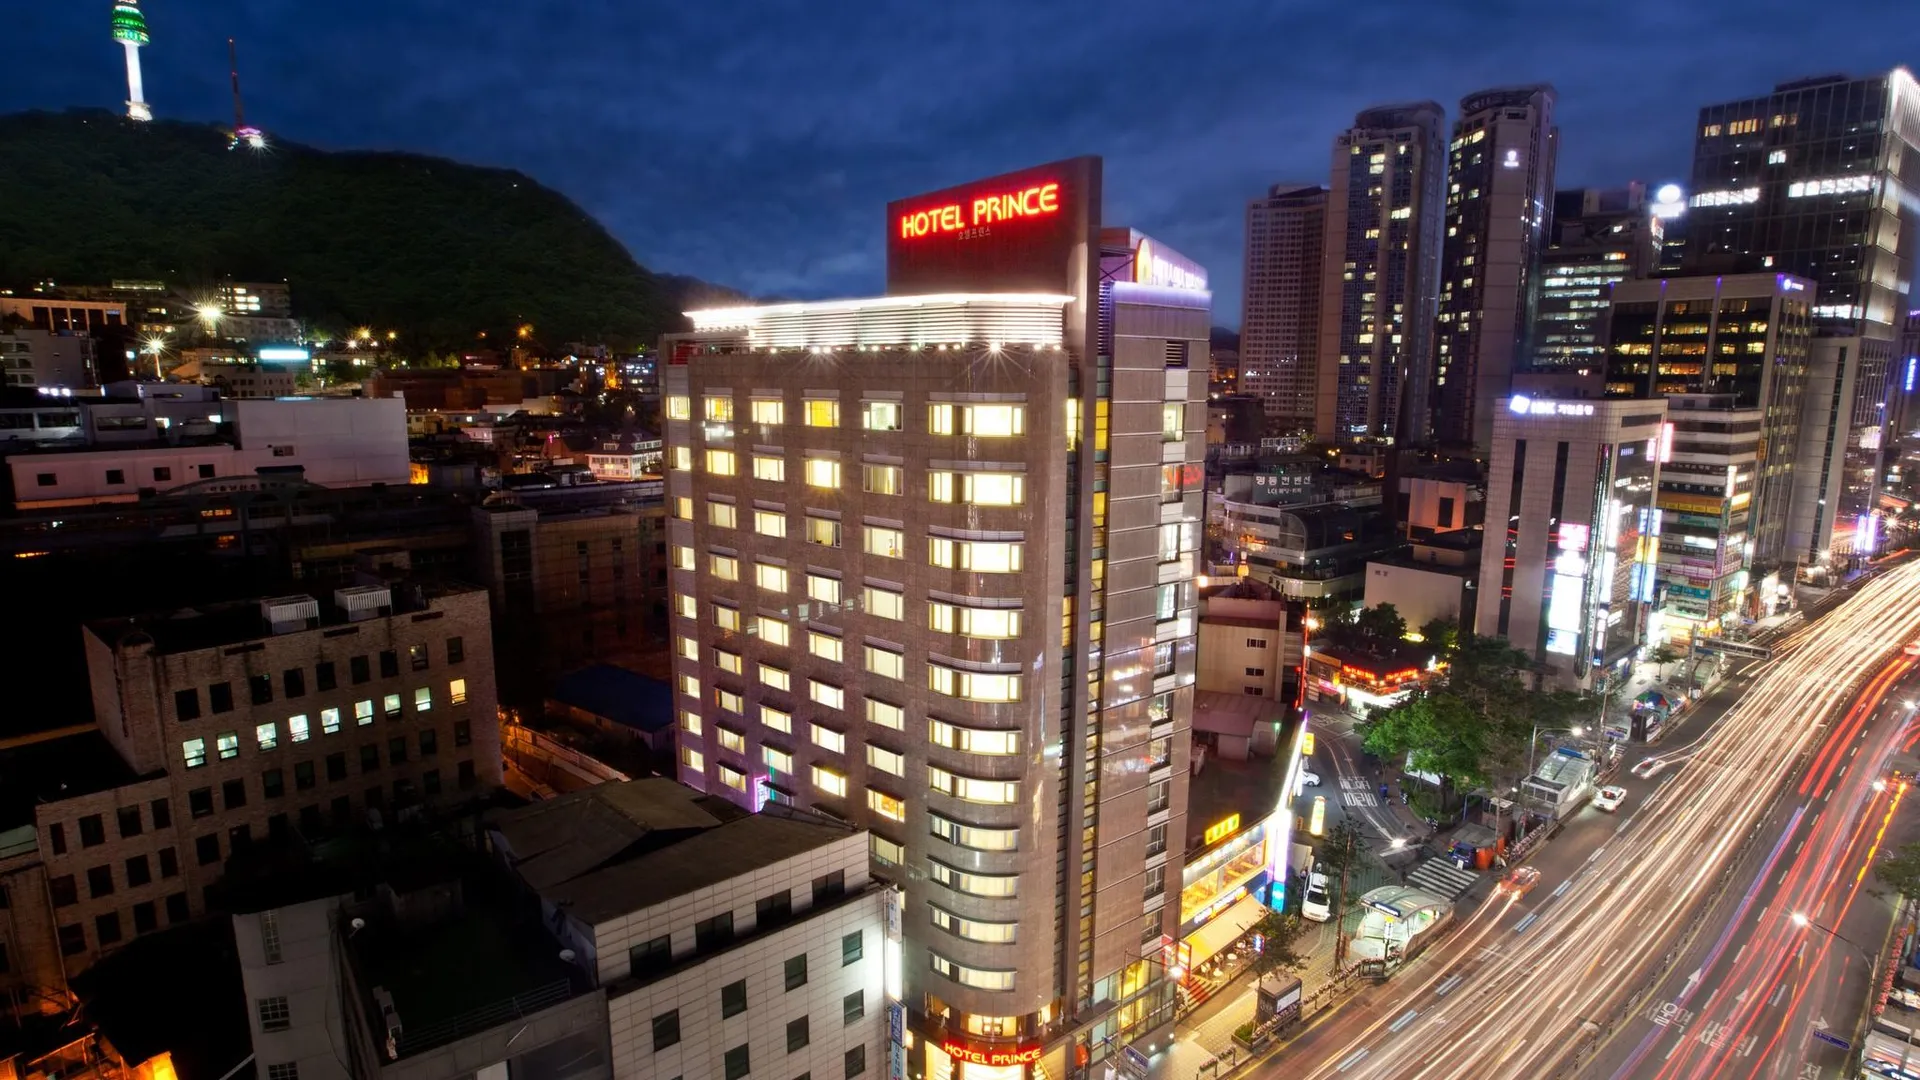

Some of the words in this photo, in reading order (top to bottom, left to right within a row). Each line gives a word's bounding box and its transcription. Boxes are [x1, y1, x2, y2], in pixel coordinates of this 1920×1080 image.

[902, 204, 965, 239] HOTEL
[973, 183, 1059, 226] PRINCE
[1640, 998, 1695, 1033] 서울역
[944, 1042, 988, 1064] HOTEL
[992, 1048, 1041, 1065] PRINCE
